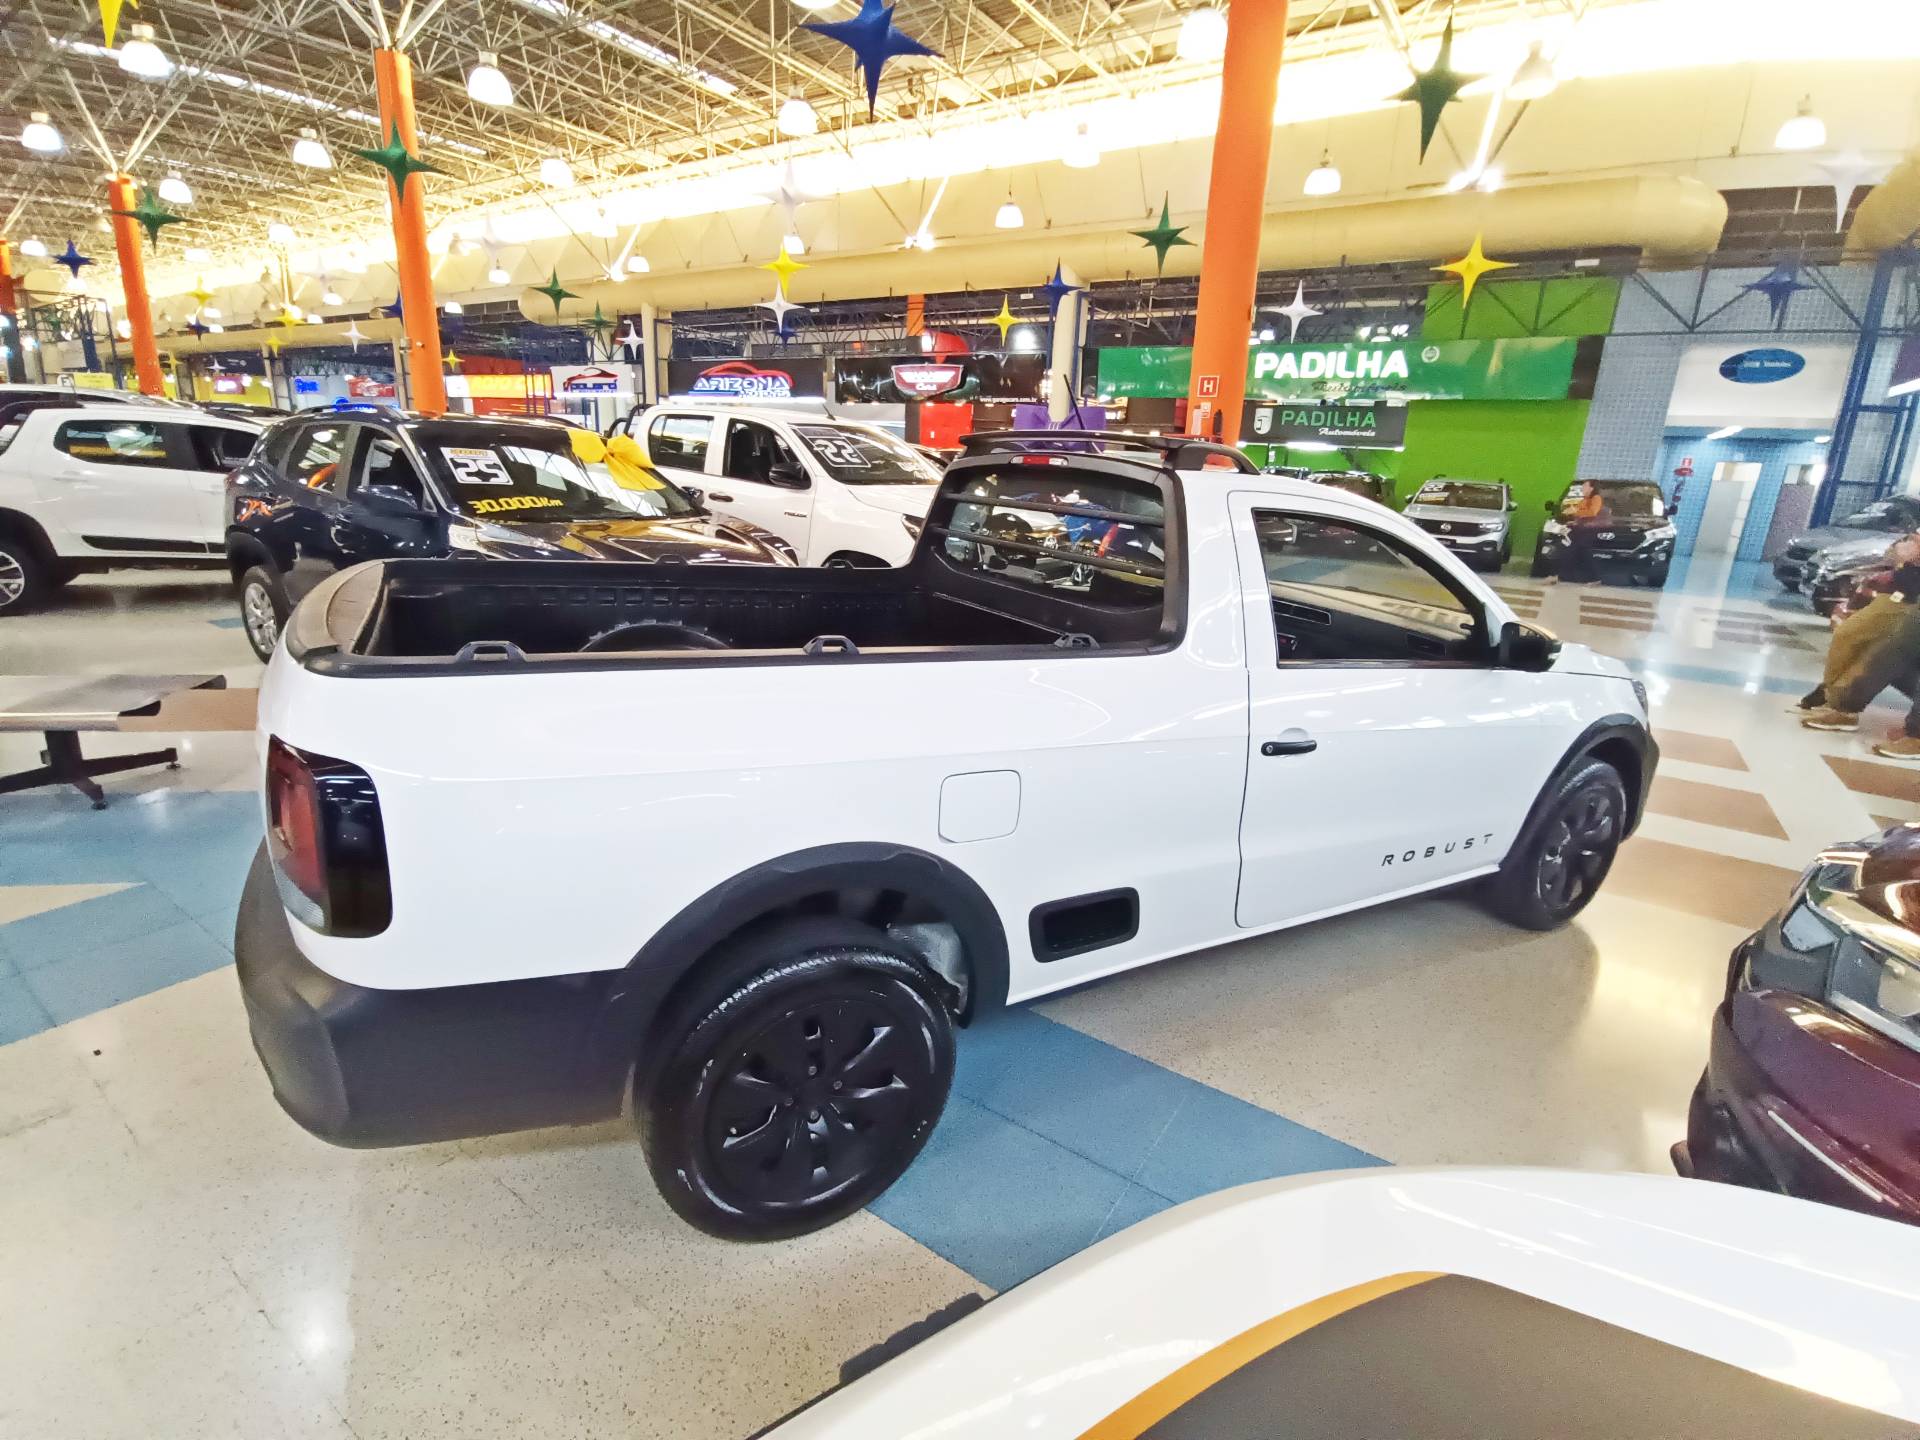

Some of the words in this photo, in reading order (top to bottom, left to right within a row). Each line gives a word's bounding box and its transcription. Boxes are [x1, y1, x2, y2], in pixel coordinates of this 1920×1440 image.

[1254, 350, 1409, 379] PADILHA
[692, 376, 790, 391] ARIZONA
[1203, 380, 1213, 392] H
[1281, 410, 1377, 428] PADILHA
[452, 458, 510, 482] 25
[1381, 833, 1493, 866] ROBUST
